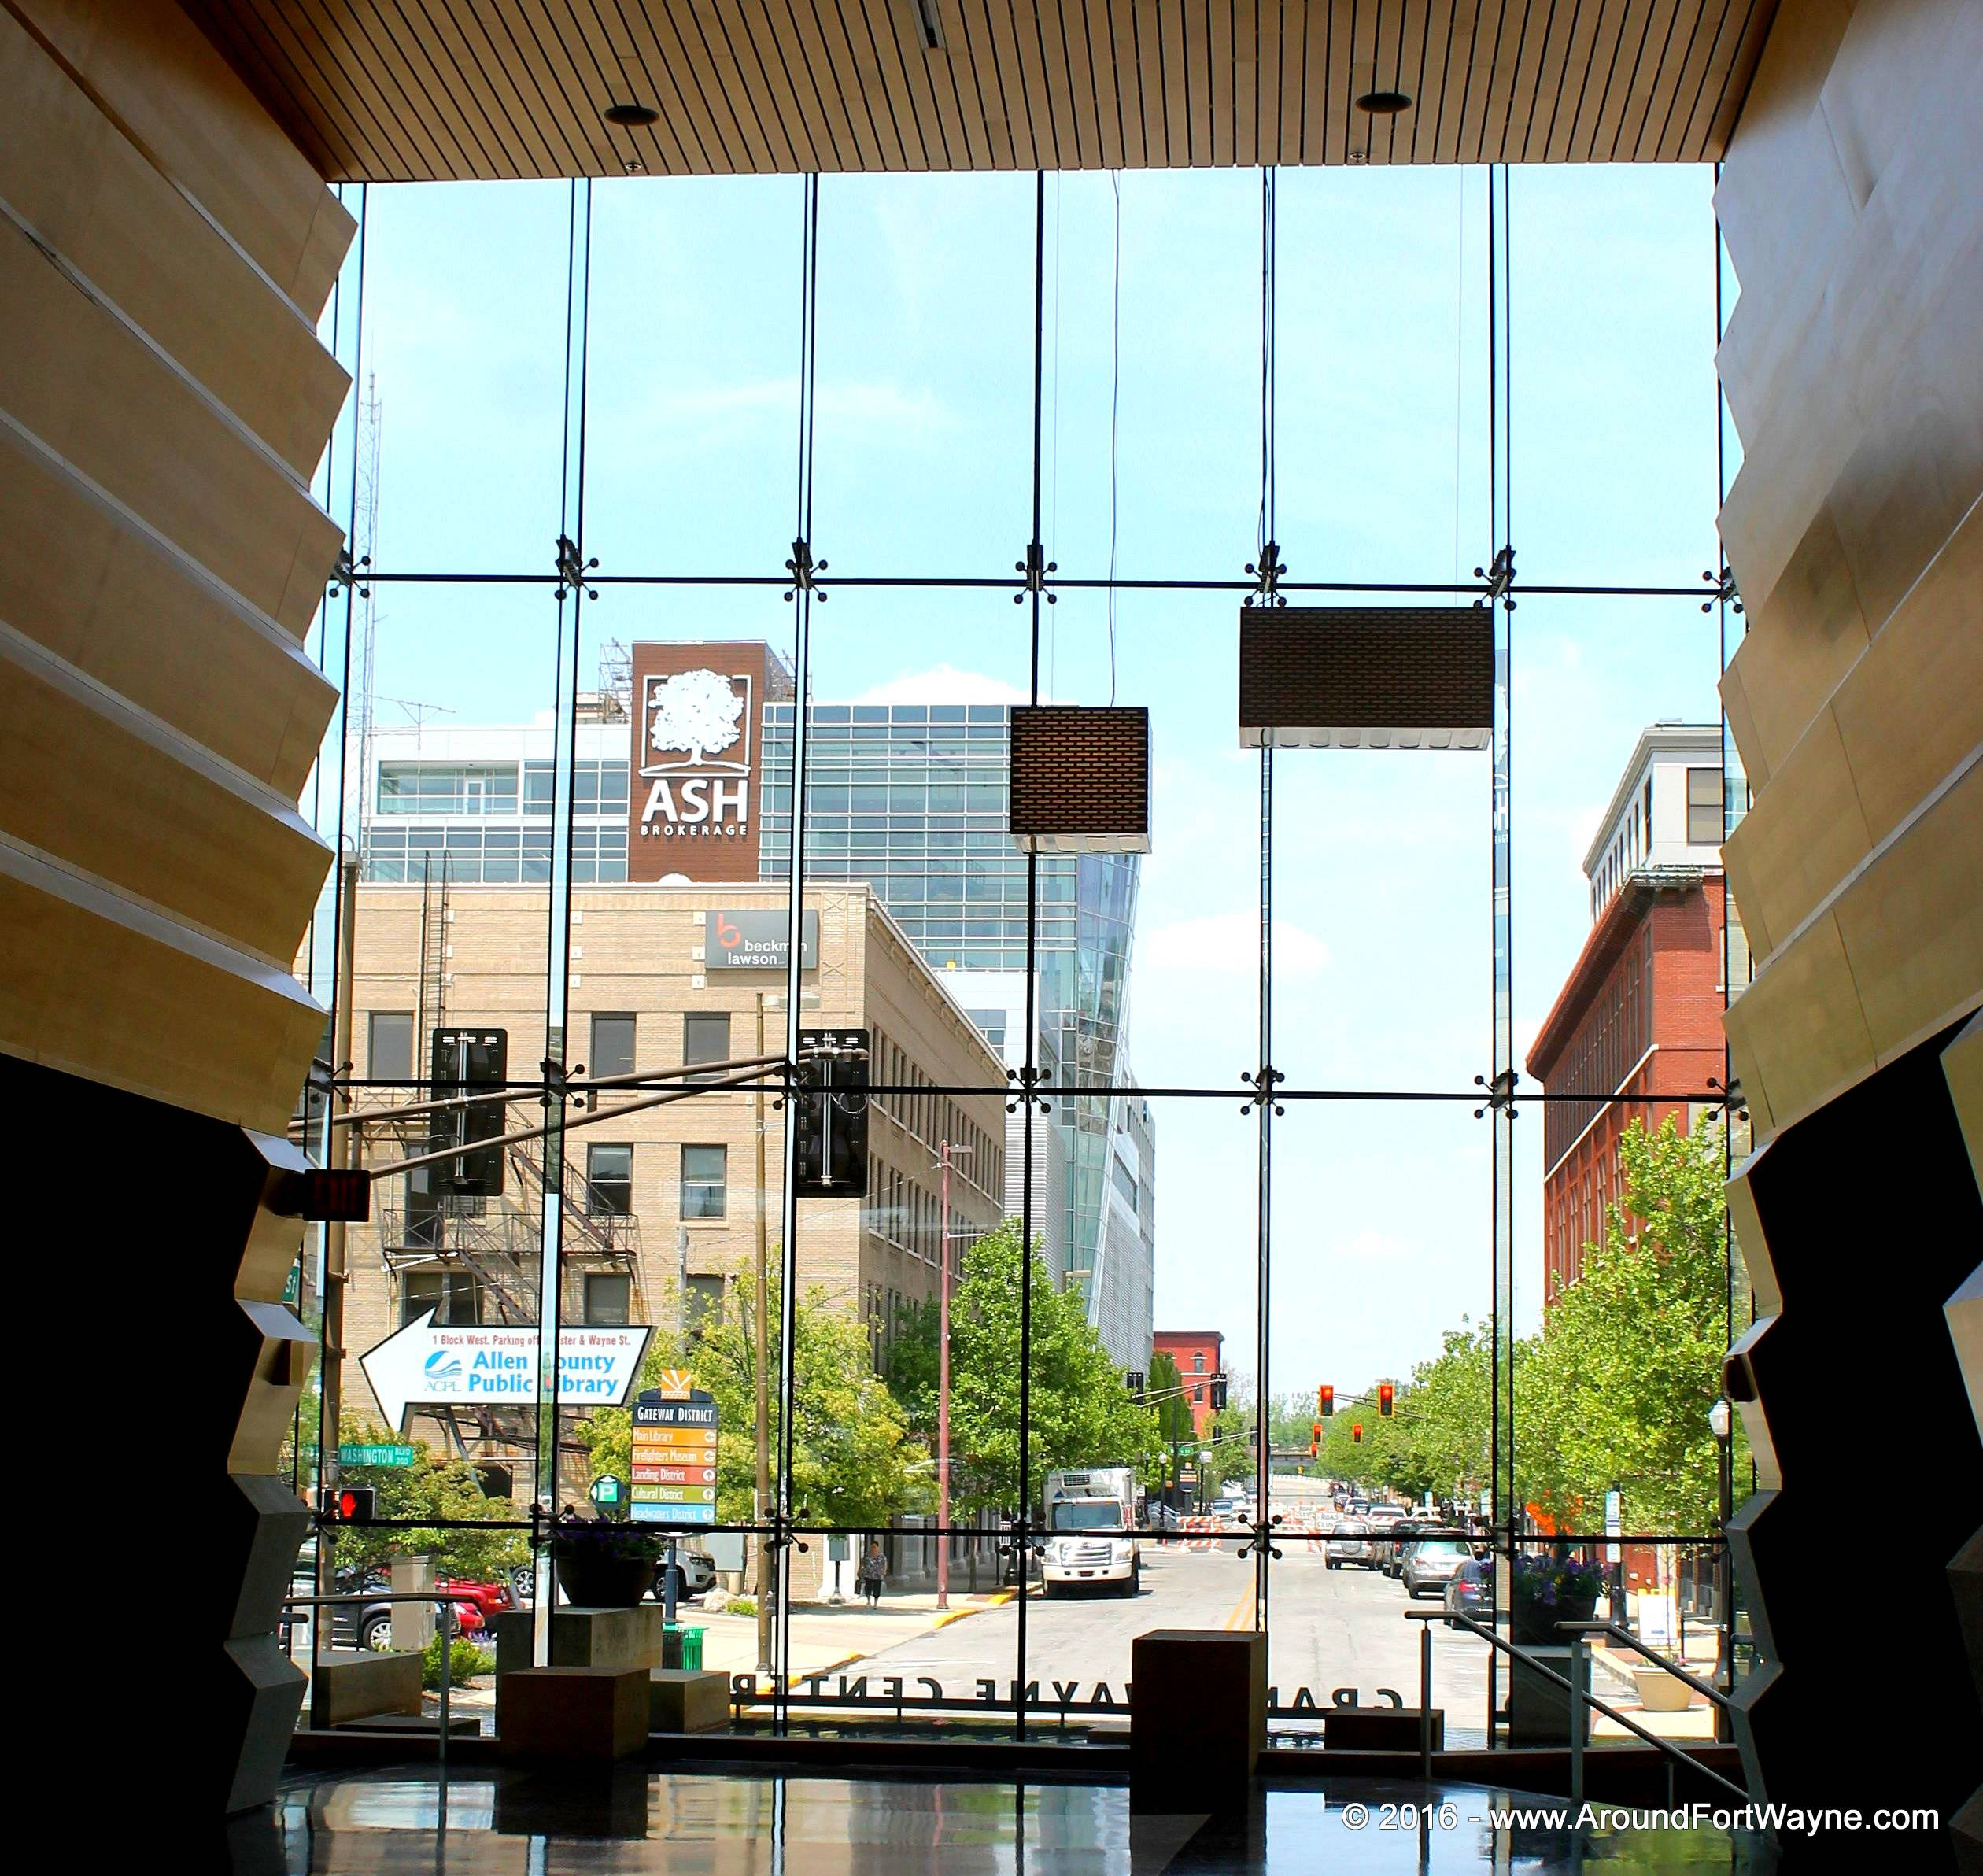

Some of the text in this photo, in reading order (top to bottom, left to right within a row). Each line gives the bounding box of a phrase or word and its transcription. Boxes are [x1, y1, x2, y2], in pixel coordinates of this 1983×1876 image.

[641, 778, 748, 823] ASH
[641, 825, 748, 836] BROKERAGE
[744, 939, 807, 952] beckmn
[727, 951, 777, 965] lawson
[285, 1273, 297, 1294] St
[433, 1335, 438, 1345] 1
[441, 1335, 464, 1345] Block
[493, 1335, 525, 1347] Parking
[589, 1335, 617, 1347] Wayne
[619, 1335, 631, 1346] St.
[473, 1350, 616, 1373] Allen ounty
[423, 1380, 463, 1392] ACPL
[468, 1374, 534, 1393] Public
[649, 1430, 674, 1443] Library
[340, 1447, 411, 1464] WASHINGTON BLVD
[632, 1448, 697, 1462] Firefighters Museum
[631, 1468, 685, 1482] Landing District
[602, 1485, 614, 1501] P
[631, 1486, 684, 1500] Cultural District
[672, 1507, 697, 1520] District
